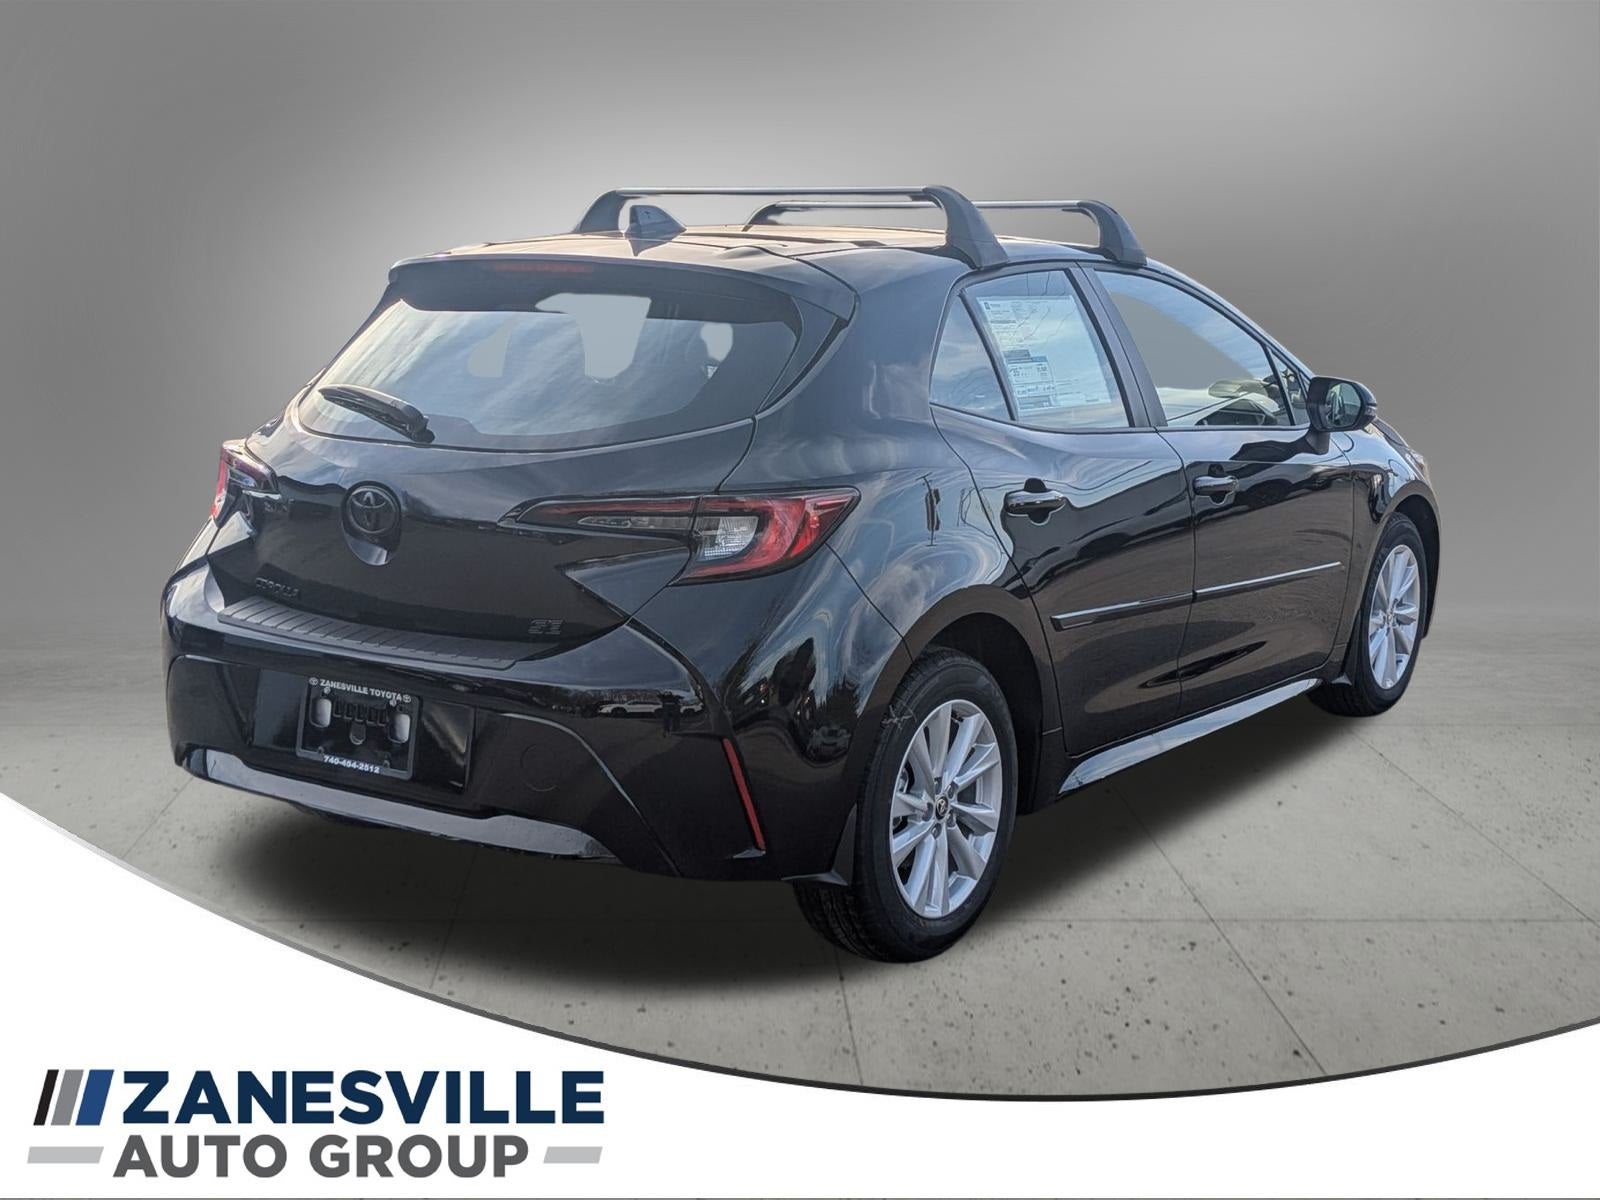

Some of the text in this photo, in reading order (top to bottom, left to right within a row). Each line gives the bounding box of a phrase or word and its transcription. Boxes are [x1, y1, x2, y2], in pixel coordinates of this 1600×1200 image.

[319, 679, 402, 702] ZANESVILLE TOYOTA
[323, 755, 381, 774] 740-454-2512
